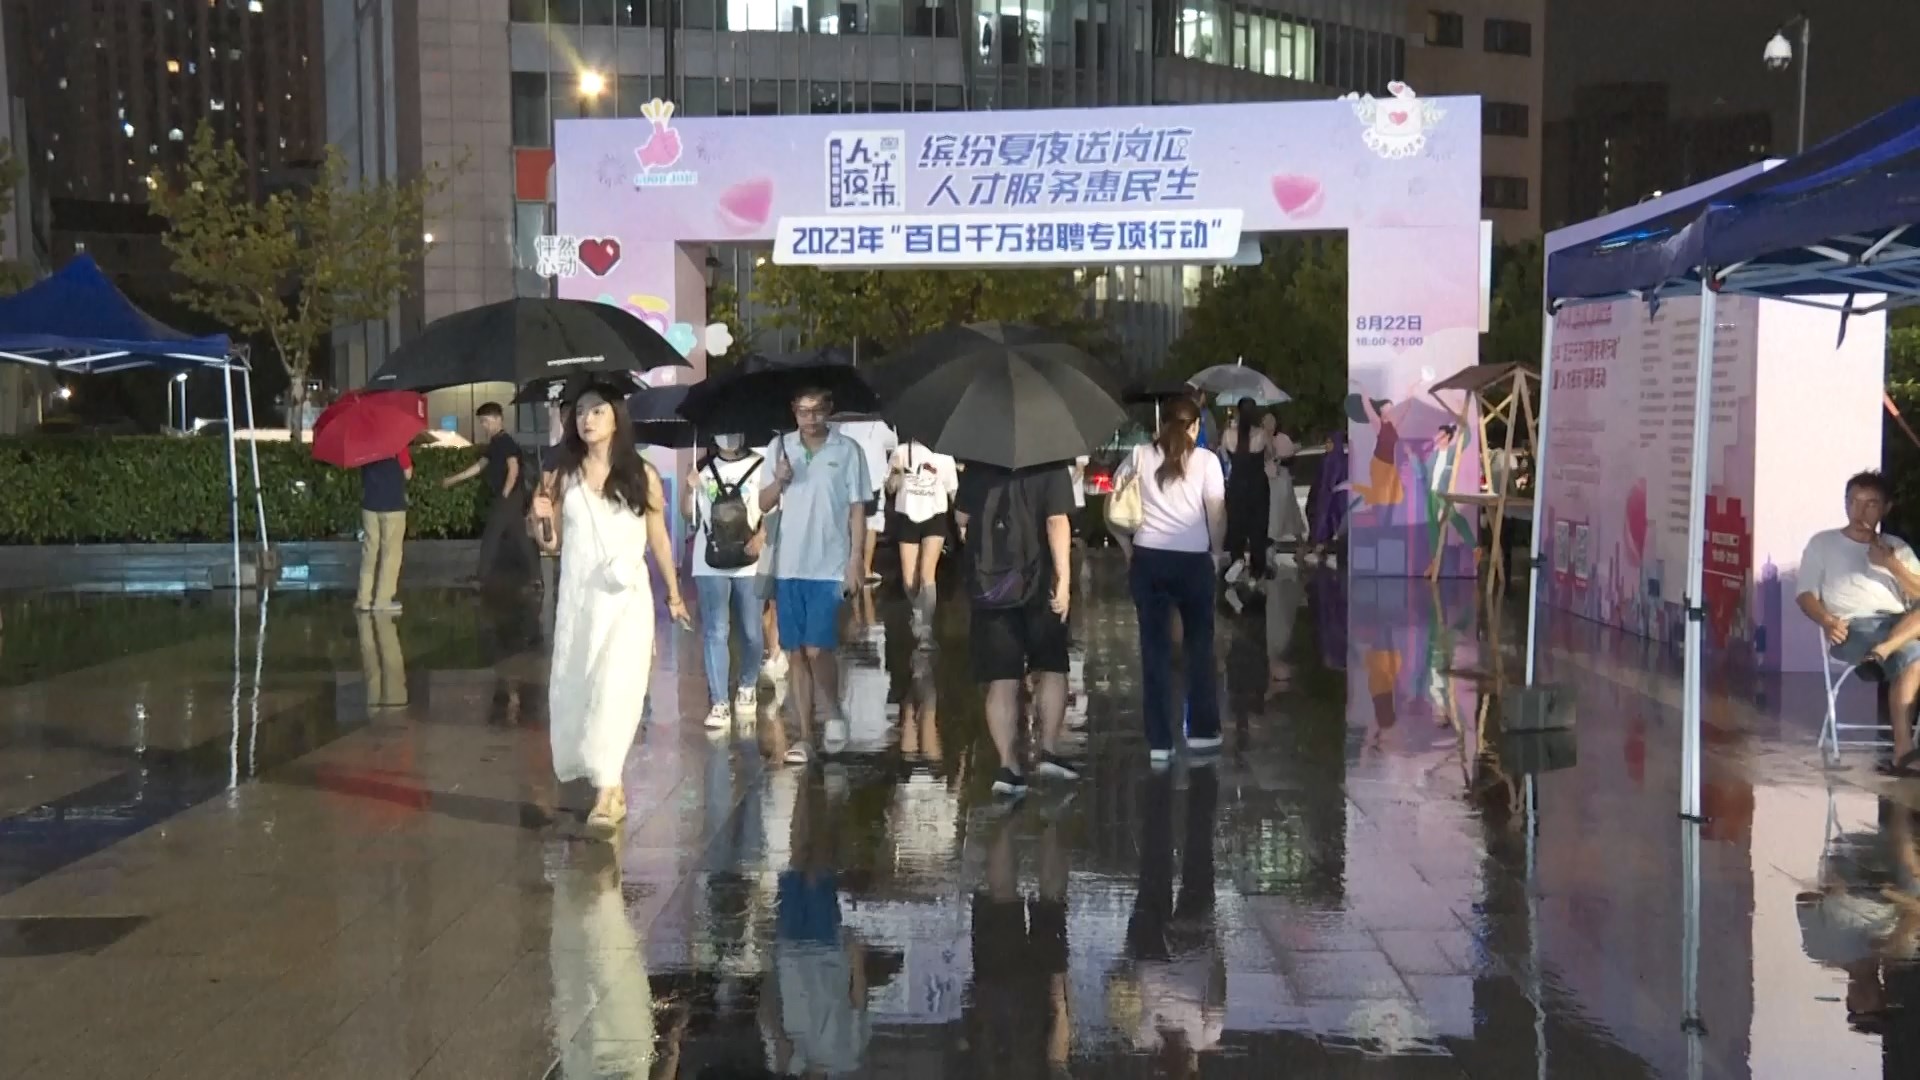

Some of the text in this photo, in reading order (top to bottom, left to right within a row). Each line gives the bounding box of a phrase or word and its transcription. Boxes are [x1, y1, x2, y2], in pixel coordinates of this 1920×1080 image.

[918, 126, 1193, 168] 缤纷夏夜送岗位
[926, 165, 1199, 207] 人才服务惠民生
[1356, 315, 1422, 331] 8月22日
